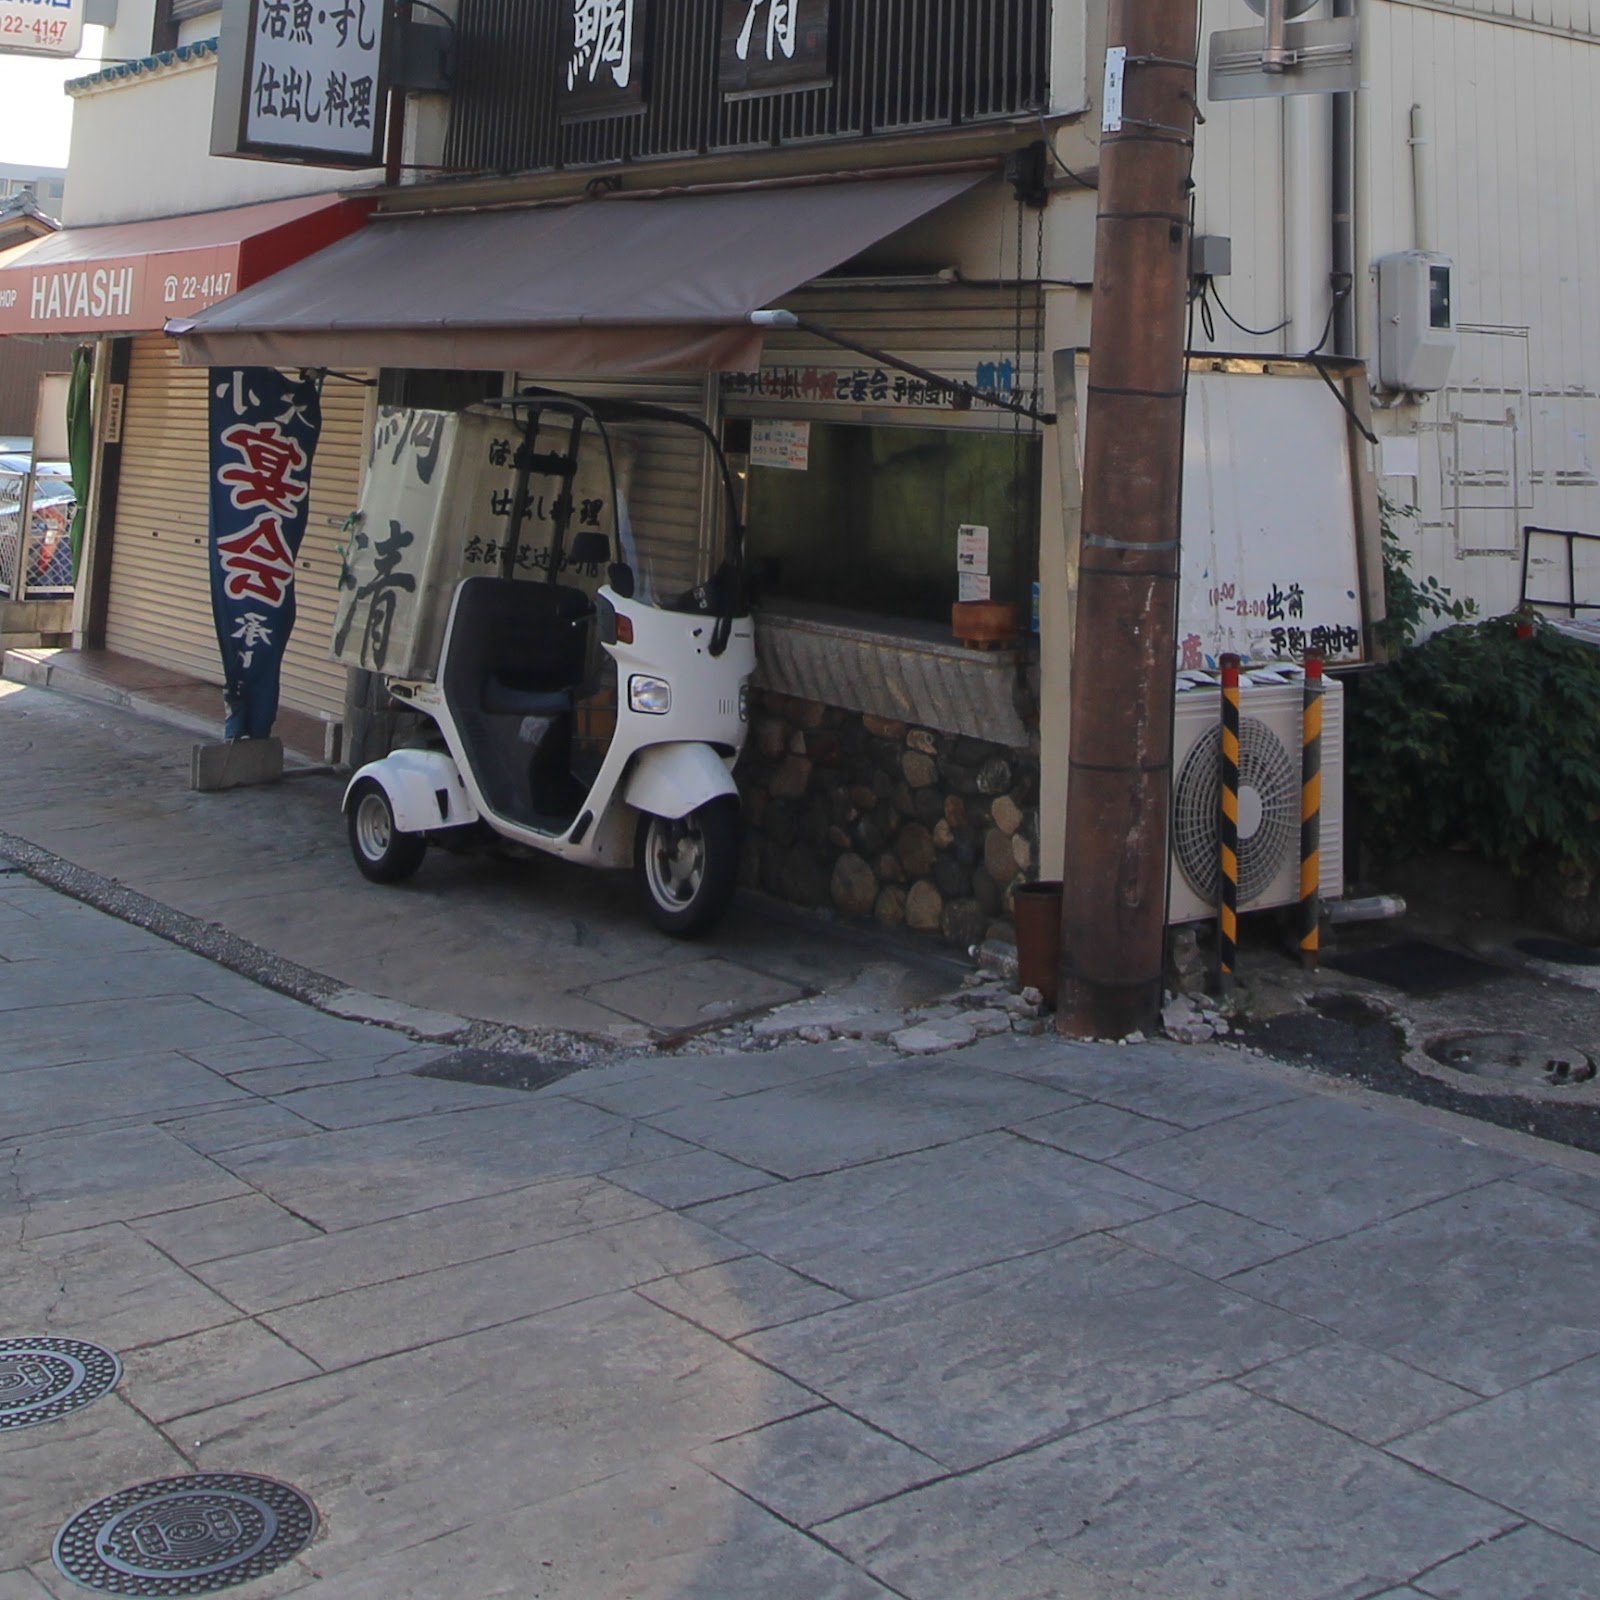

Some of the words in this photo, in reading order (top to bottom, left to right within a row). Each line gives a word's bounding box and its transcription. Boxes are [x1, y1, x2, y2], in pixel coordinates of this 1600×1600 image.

[254, 61, 374, 130] 仕出し料理
[30, 267, 134, 320] HAYASHI
[182, 272, 232, 299] 22-4147
[1267, 582, 1304, 621] 出前
